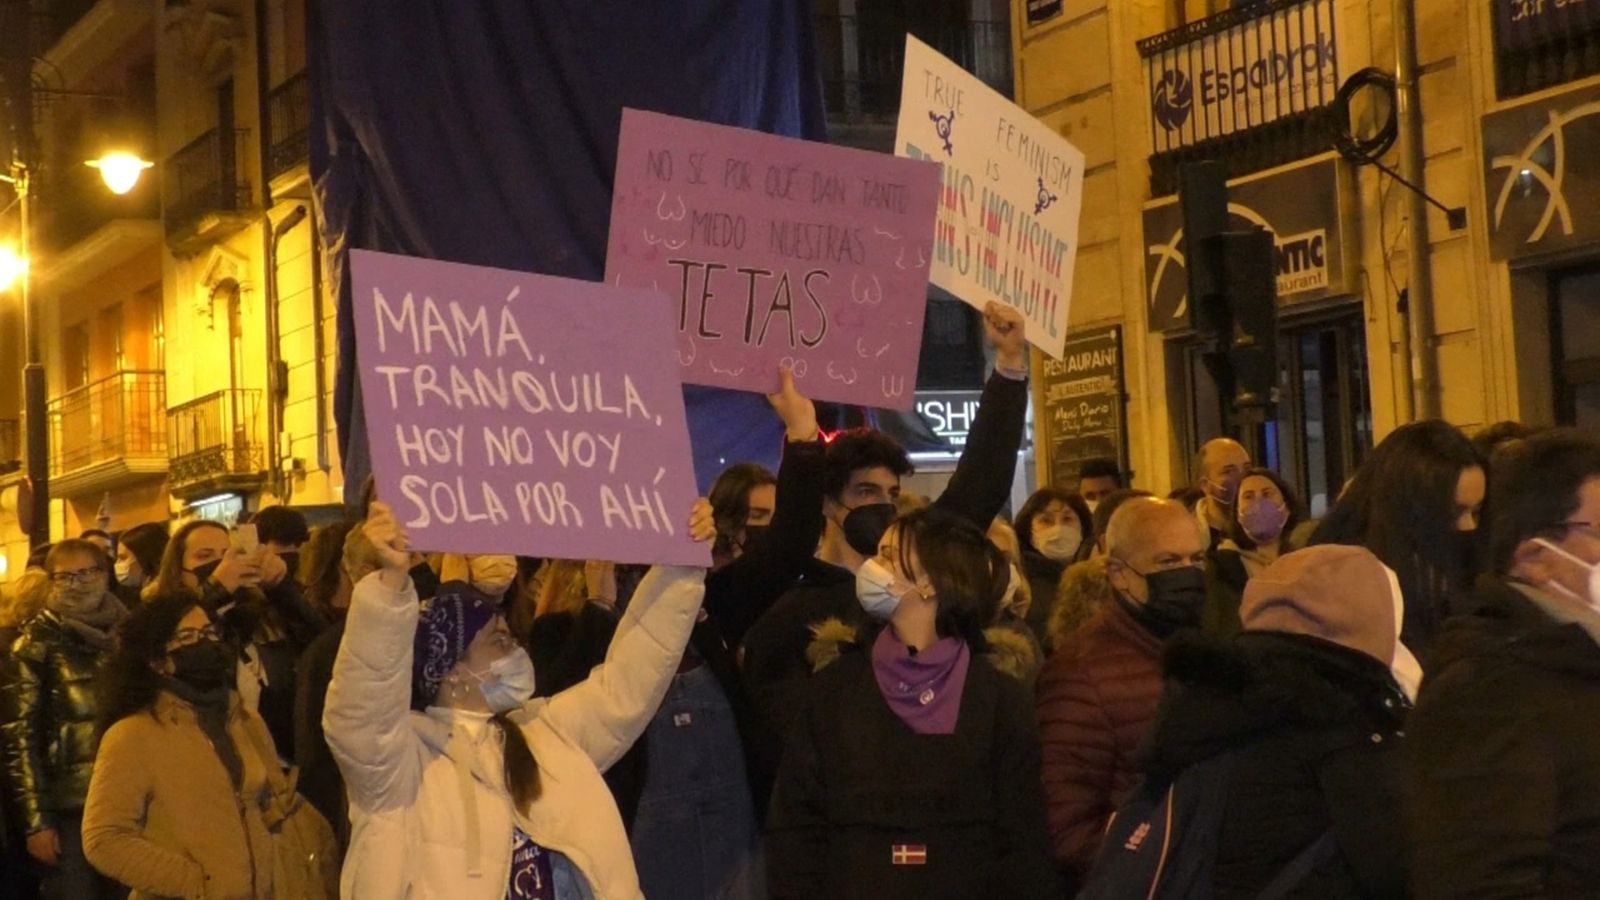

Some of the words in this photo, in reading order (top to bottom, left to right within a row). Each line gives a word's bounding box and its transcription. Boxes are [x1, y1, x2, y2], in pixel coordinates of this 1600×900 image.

[923, 68, 964, 117] TRUE
[1201, 32, 1336, 106] Espabrok
[647, 149, 673, 182] NO
[724, 158, 752, 192] POR
[812, 170, 846, 204] DAN
[985, 159, 1001, 182] IS
[997, 117, 1072, 194] FEMINISM
[690, 209, 747, 251] MIEDO
[769, 221, 865, 265] NUESTRAS
[668, 259, 830, 348] TETAS
[1043, 346, 1117, 377] RESTAURANT
[396, 424, 464, 467] HOY
[484, 427, 534, 467] NO
[546, 430, 622, 474] VOY
[400, 475, 509, 529] SOLA
[516, 482, 583, 529] POR
[601, 467, 675, 537] AHÍ
